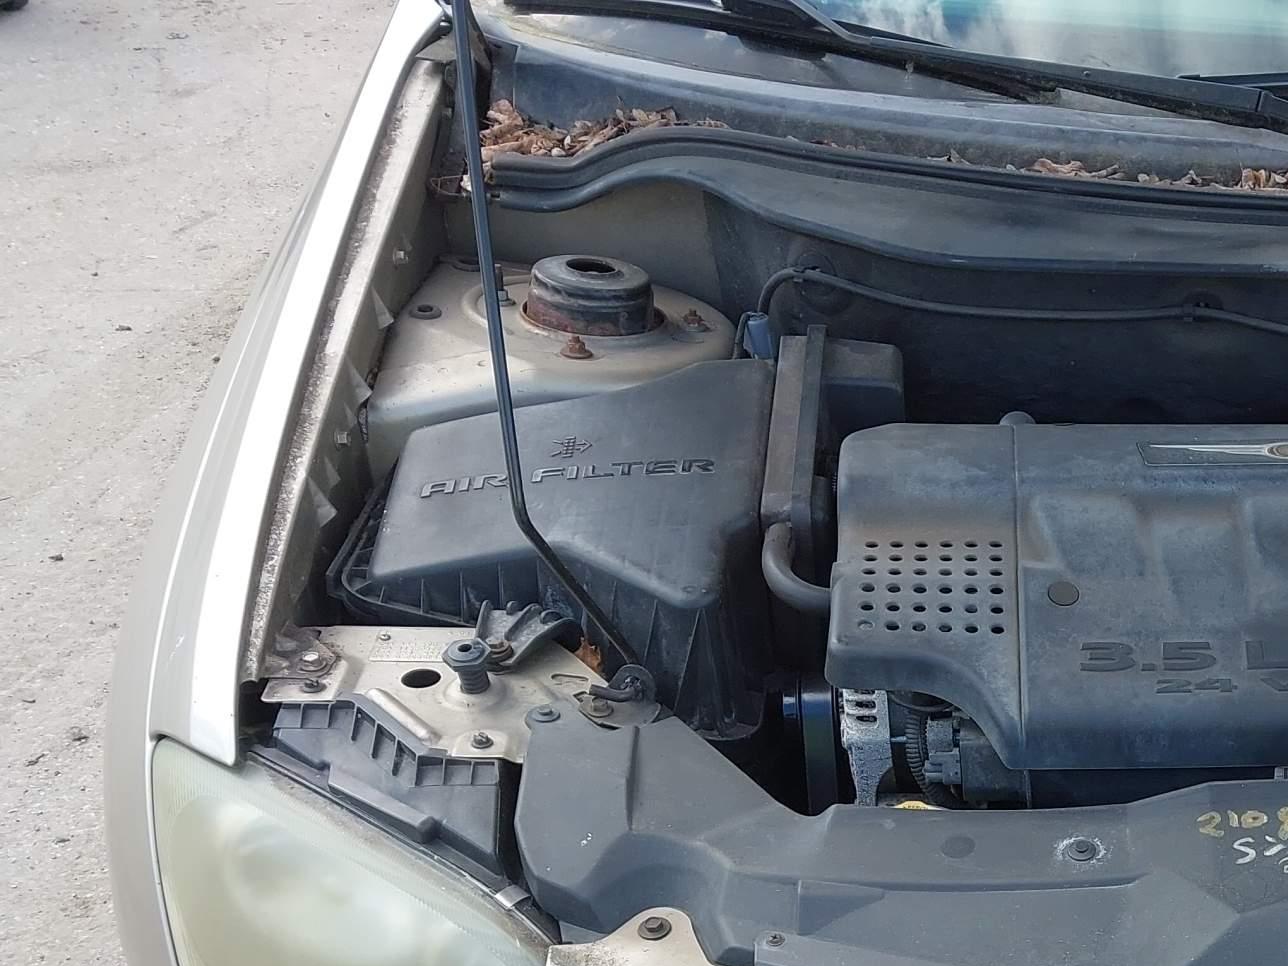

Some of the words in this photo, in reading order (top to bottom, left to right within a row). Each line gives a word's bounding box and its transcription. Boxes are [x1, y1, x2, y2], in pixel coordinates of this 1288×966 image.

[420, 474, 509, 498] AIR
[531, 458, 715, 483] FILTER
[1079, 640, 1217, 672] 3.5
[1155, 677, 1239, 694] 24
